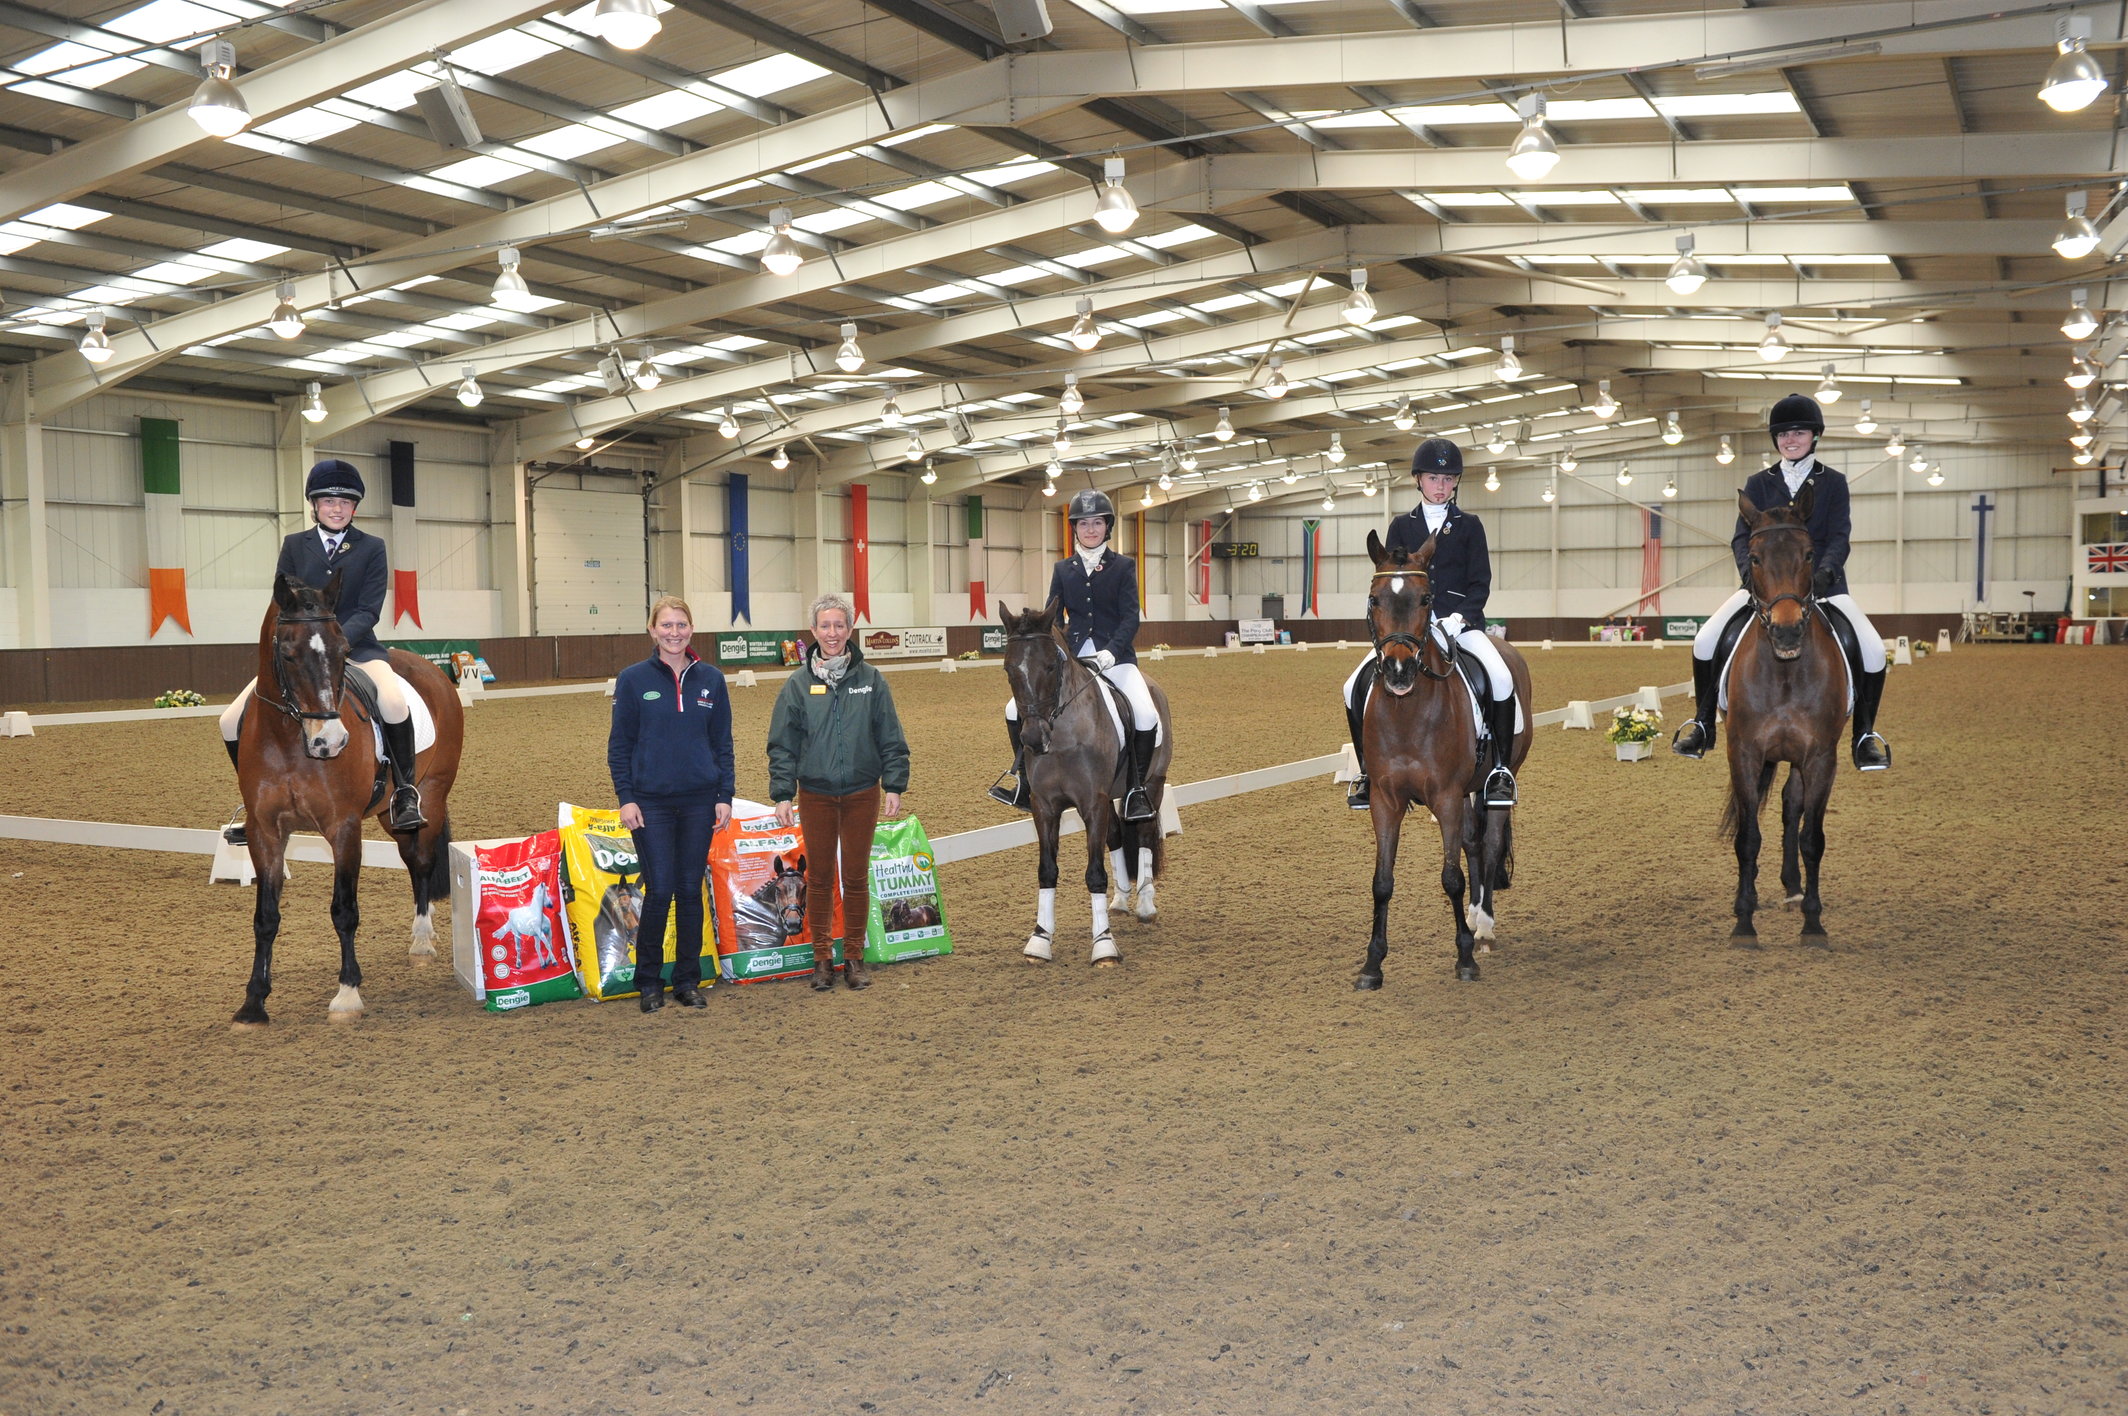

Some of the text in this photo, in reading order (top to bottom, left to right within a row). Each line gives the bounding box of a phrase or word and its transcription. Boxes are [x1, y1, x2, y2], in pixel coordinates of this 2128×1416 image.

[1669, 624, 1695, 632] Dengie
[1899, 639, 1906, 647] R
[722, 643, 746, 654] Dengie
[848, 685, 872, 694] Dengie
[739, 836, 793, 847] ALFA-A
[876, 861, 913, 877] Healthy
[877, 873, 931, 891] TUMMY
[880, 890, 910, 898] COMPLETE
[753, 957, 781, 967] Dengie
[497, 994, 528, 1006] Dengie
